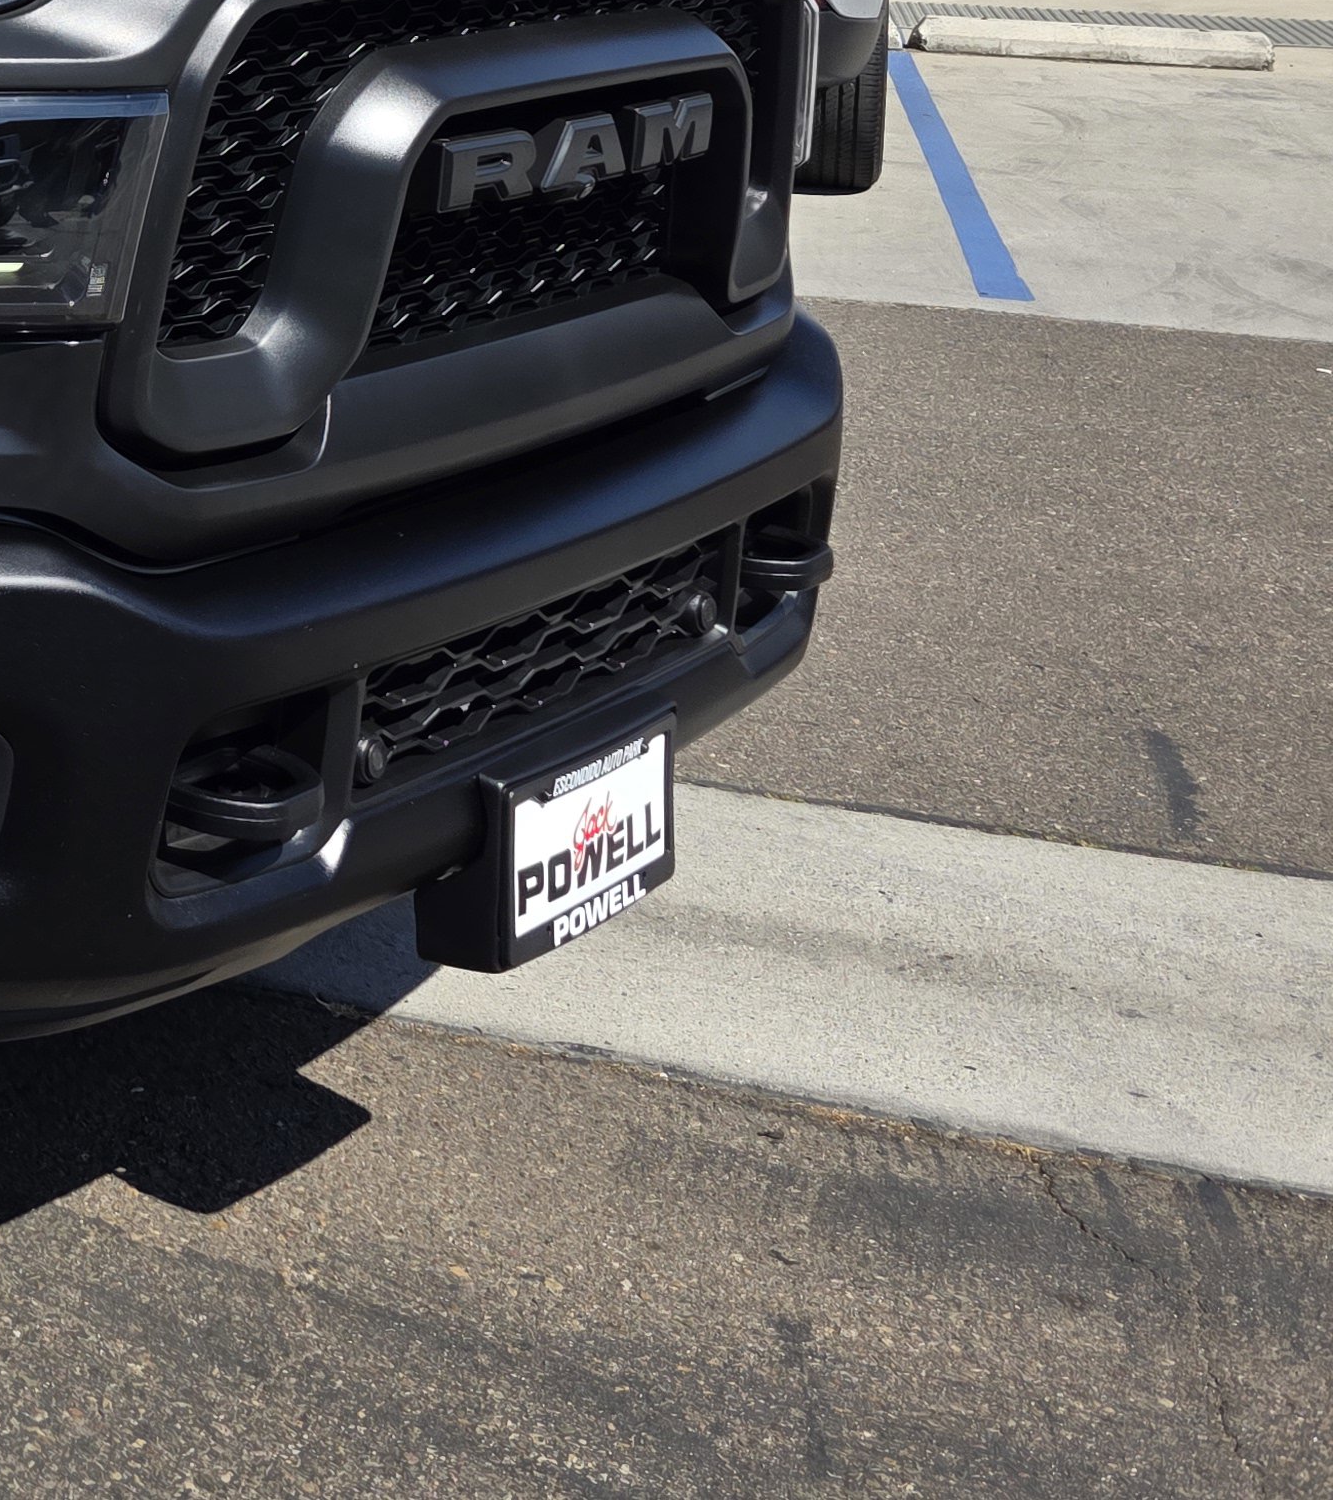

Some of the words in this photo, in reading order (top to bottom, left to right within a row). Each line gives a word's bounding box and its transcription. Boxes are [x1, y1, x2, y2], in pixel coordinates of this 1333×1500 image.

[437, 93, 714, 213] RAM
[552, 758, 603, 798] ESCONDIDO
[601, 748, 624, 776] AUTO
[623, 736, 645, 764] PARK
[517, 801, 662, 918] POWELL
[572, 790, 618, 871] Jack
[552, 873, 647, 948] POWELL
